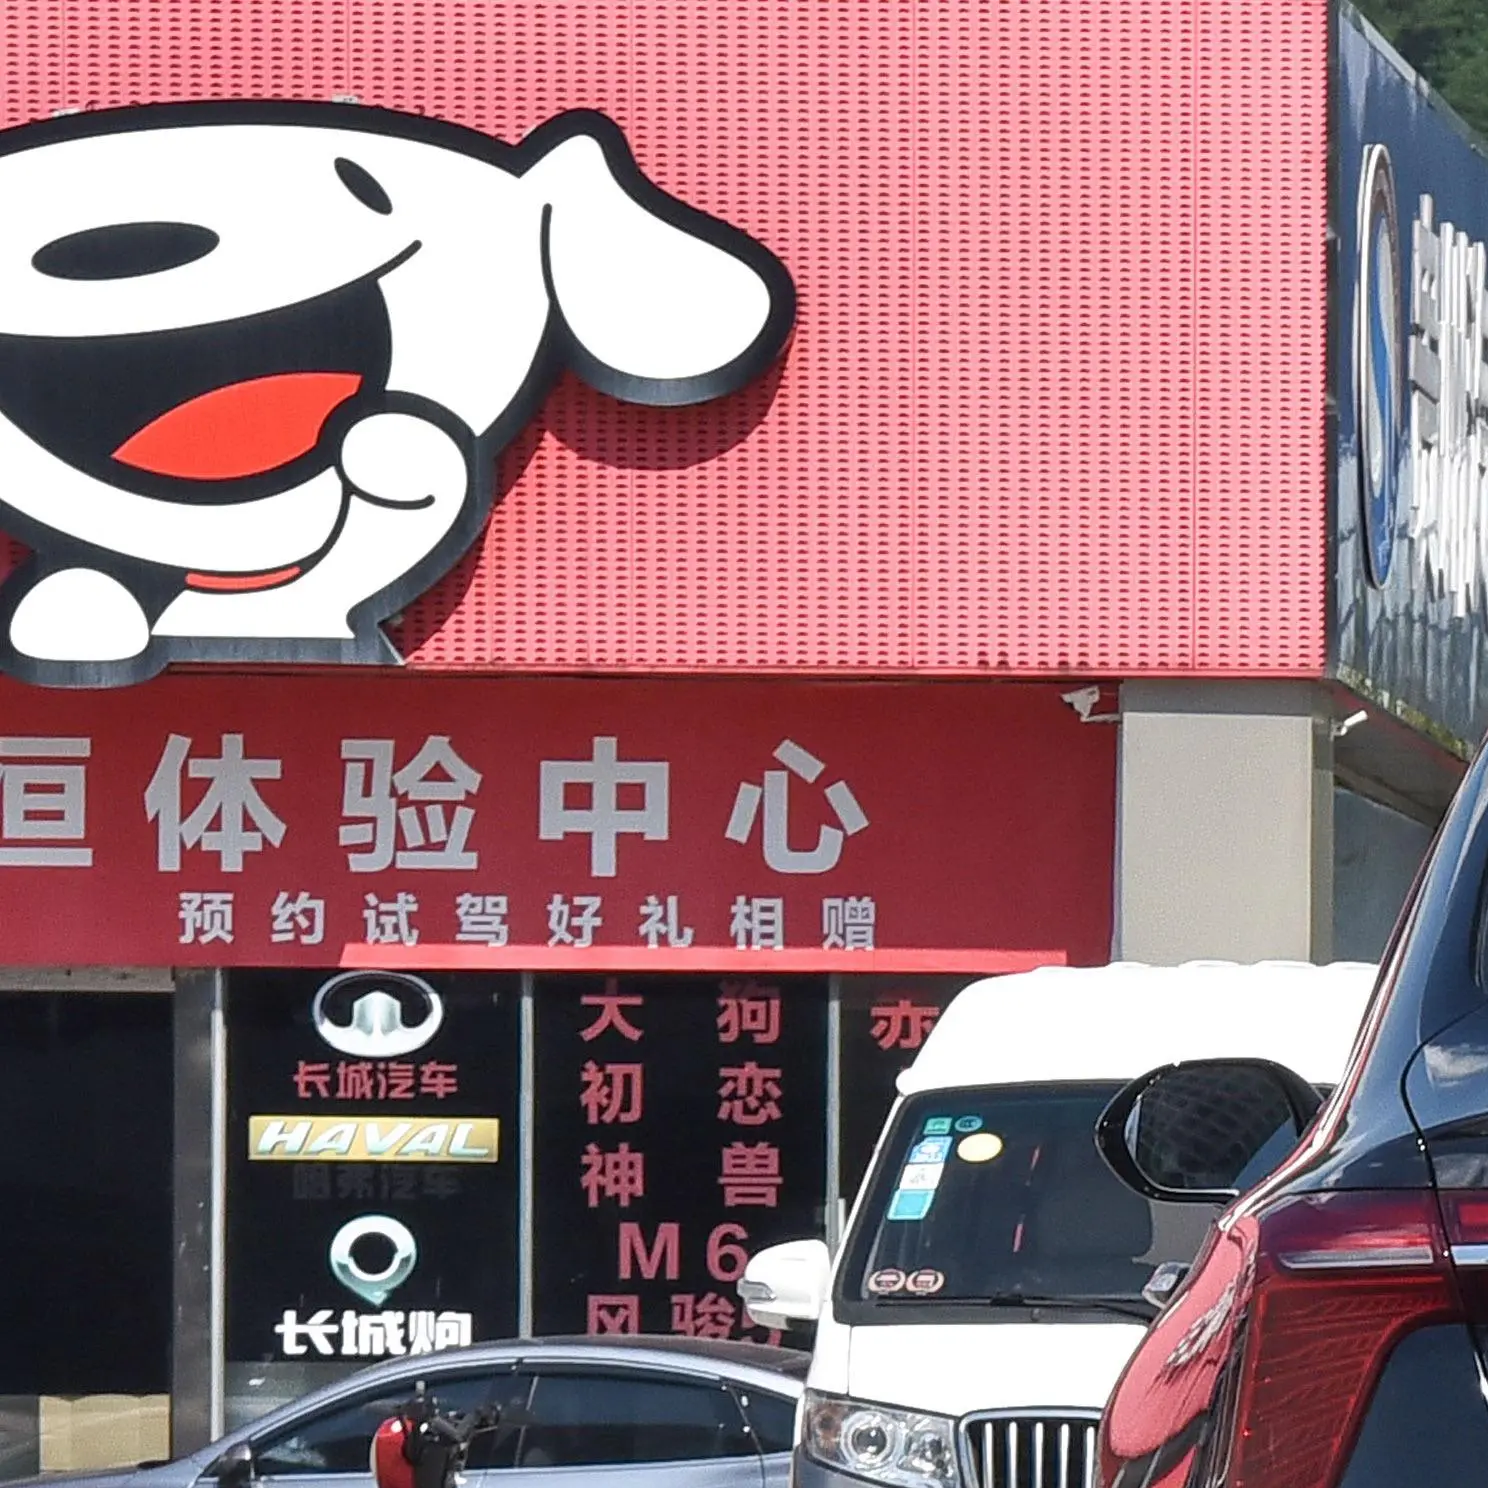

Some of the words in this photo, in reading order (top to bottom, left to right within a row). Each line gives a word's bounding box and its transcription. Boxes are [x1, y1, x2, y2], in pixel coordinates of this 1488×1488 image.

[178, 890, 876, 950] 预约试驾好礼相赠
[580, 977, 782, 1044] 大狗
[293, 1061, 458, 1099] 长城汽车
[580, 1061, 783, 1126] 初恋
[256, 1119, 490, 1158] HAVAL
[580, 1142, 783, 1208] 神兽
